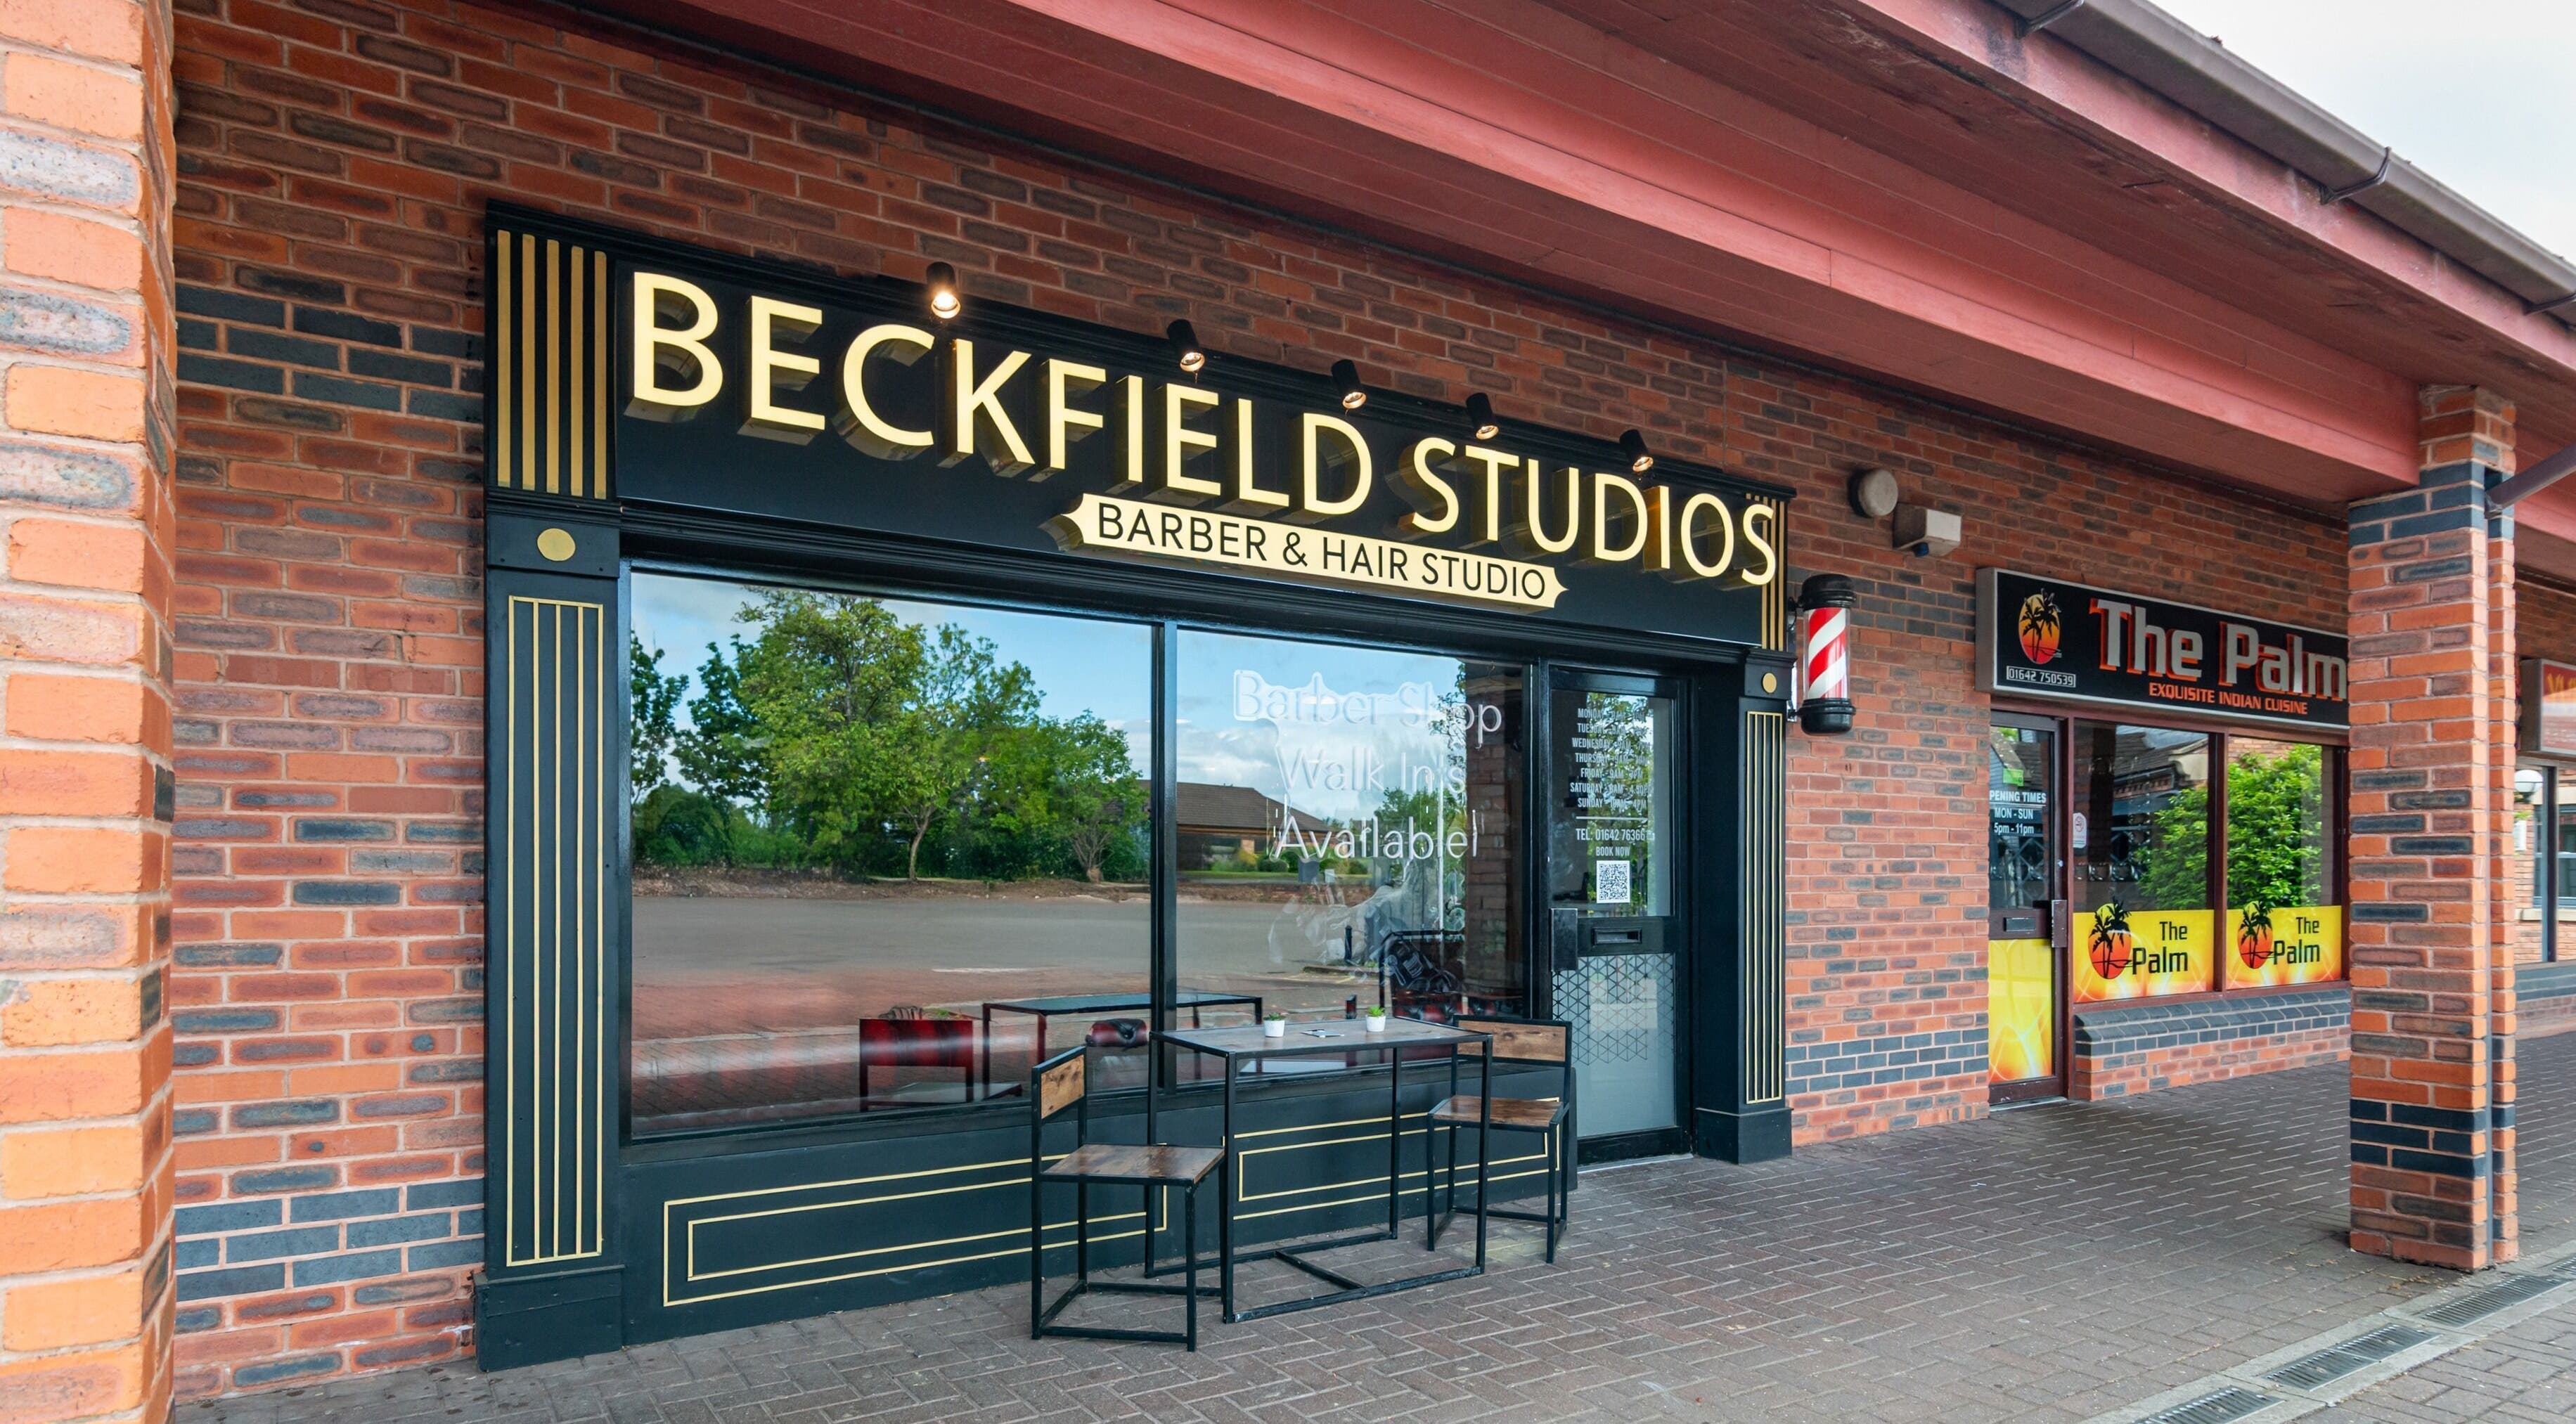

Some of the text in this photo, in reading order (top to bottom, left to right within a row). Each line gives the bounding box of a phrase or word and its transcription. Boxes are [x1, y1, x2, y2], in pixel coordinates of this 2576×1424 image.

[632, 271, 1777, 585] BECKFIELD STUDIOS
[1097, 502, 1546, 600] BARBER & HAIR STUDIO
[2089, 597, 2347, 701] The Palm
[2009, 668, 2073, 686] 01642 750539
[1235, 671, 1388, 725] Barber
[2149, 682, 2308, 715] EXQUISITE INDIAN CUISINE
[1572, 737, 1611, 749] WEDNESDAY
[1575, 753, 1608, 764] THURSDAY
[1276, 746, 1384, 791] Walk
[1580, 768, 1604, 778] FRIDAY
[1609, 769, 1624, 779] 9AM
[1570, 782, 1604, 794] SATURDAY
[1989, 789, 2047, 803] PENING TIMES
[1578, 797, 1604, 808] SUNDAY
[1994, 807, 2012, 819] MON
[2018, 808, 2034, 820] SUN
[1595, 829, 1619, 841] 01642
[1621, 829, 1651, 842] 76366
[1994, 822, 2010, 836] 5pm
[2015, 823, 2035, 836] 11pm
[1596, 846, 1630, 857] BOOK NOW
[2159, 920, 2188, 941] The
[2295, 916, 2320, 936] The
[2132, 946, 2189, 976] Palm
[2272, 939, 2321, 966] Palm
